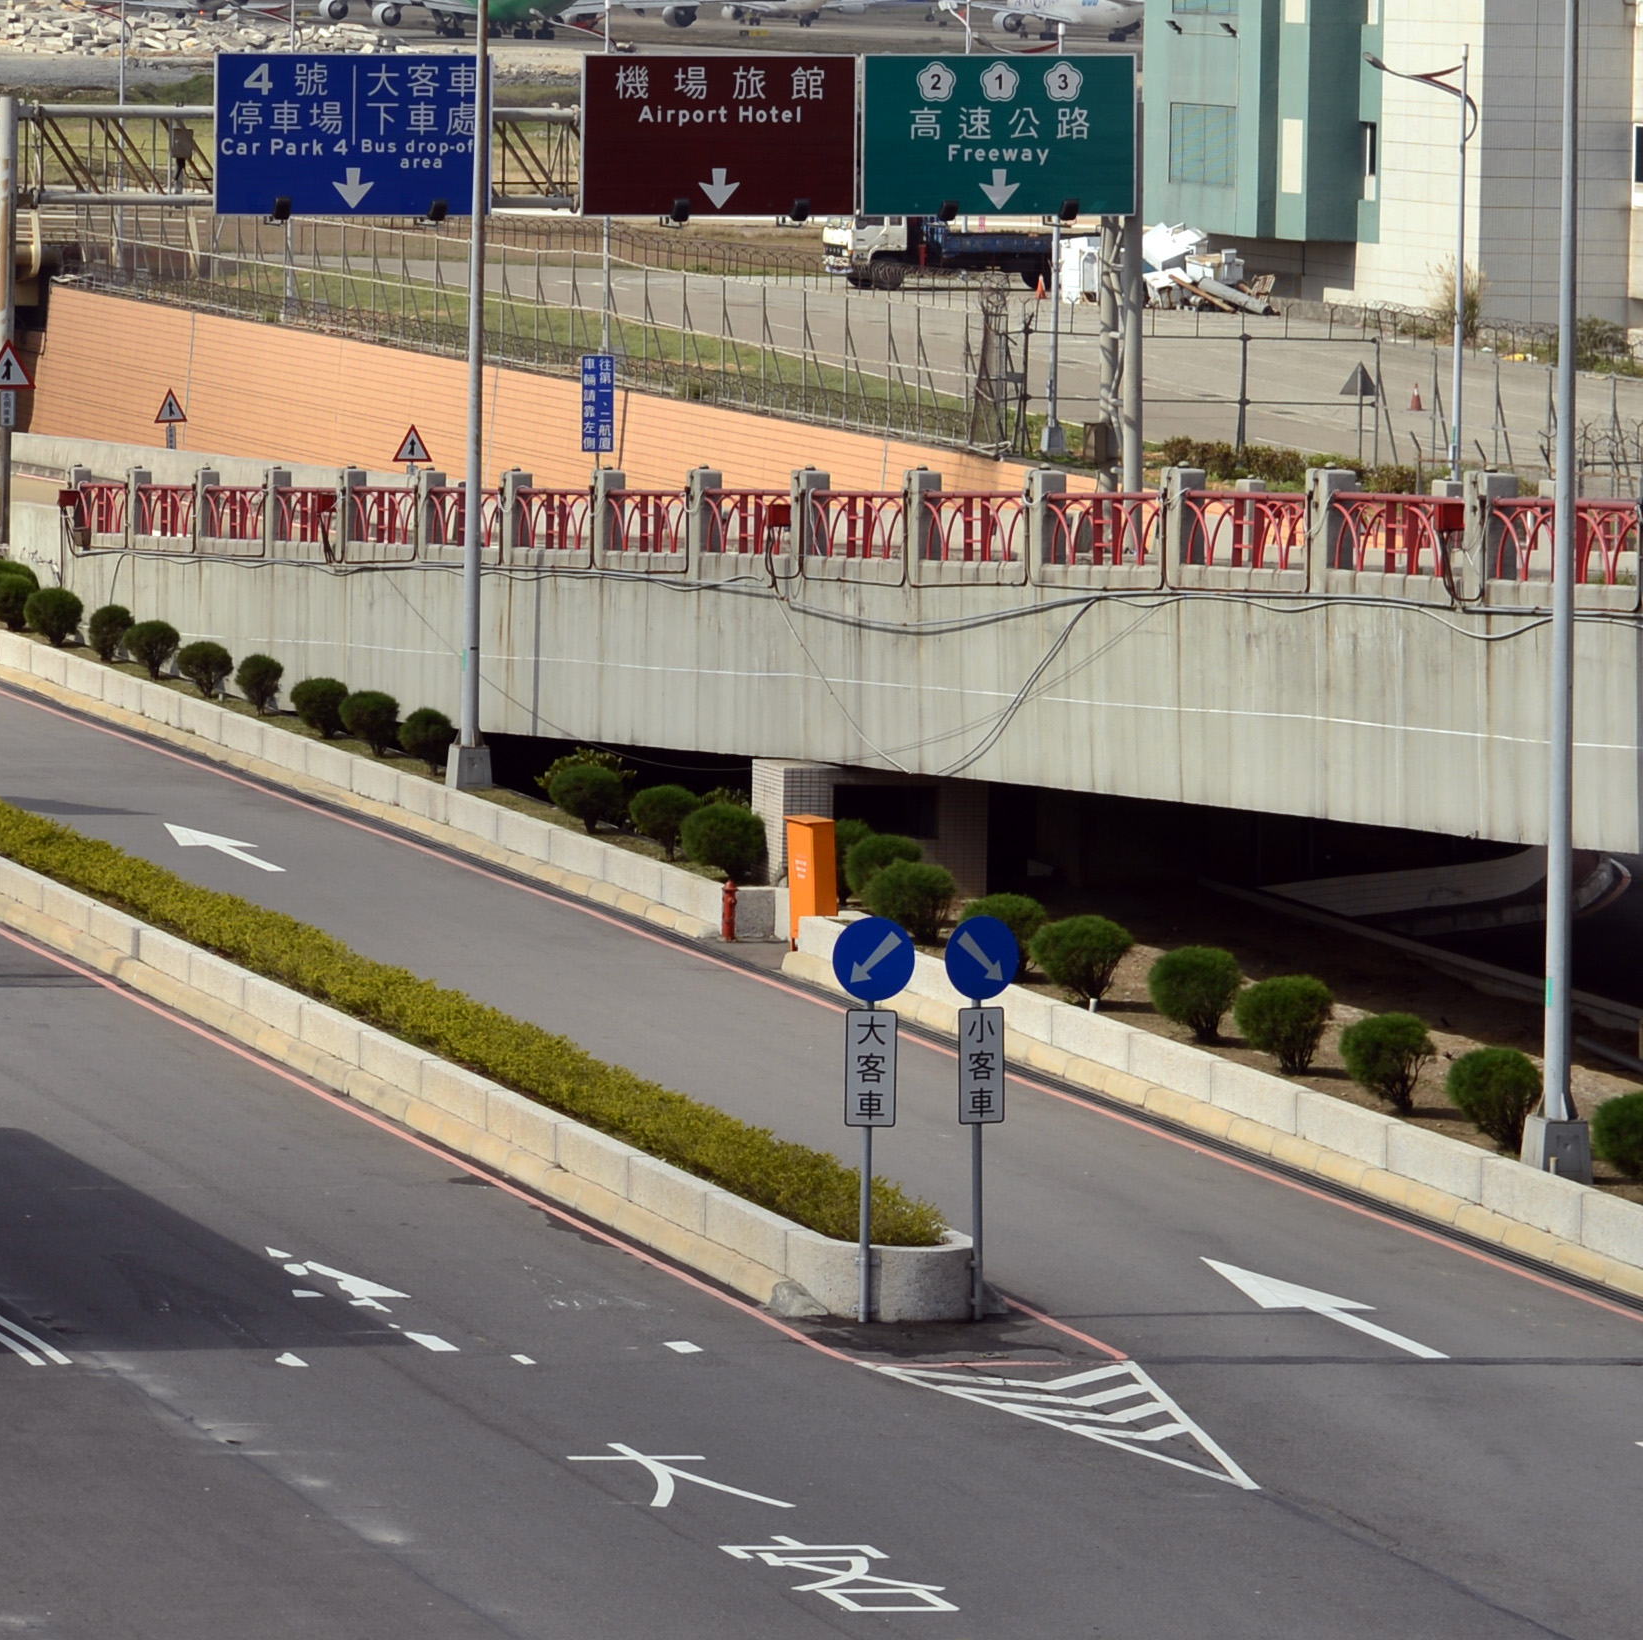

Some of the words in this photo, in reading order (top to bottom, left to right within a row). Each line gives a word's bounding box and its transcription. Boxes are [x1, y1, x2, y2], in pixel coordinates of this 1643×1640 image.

[615, 65, 825, 100] 機場旅館
[930, 73, 942, 91] 2
[994, 73, 1003, 91] 1
[1057, 73, 1069, 91] 3
[229, 100, 343, 135] 停車場
[638, 105, 728, 127] Airport
[738, 105, 802, 123] Hotel
[909, 106, 1090, 140] 高速公路
[221, 138, 261, 155] Car
[270, 138, 323, 156] Park
[333, 139, 348, 156] 4
[361, 139, 397, 153] Bus
[948, 144, 1050, 165] Freeway
[400, 157, 443, 169] area
[856, 1016, 886, 1120] 大客車
[968, 1013, 995, 1118] 小客車
